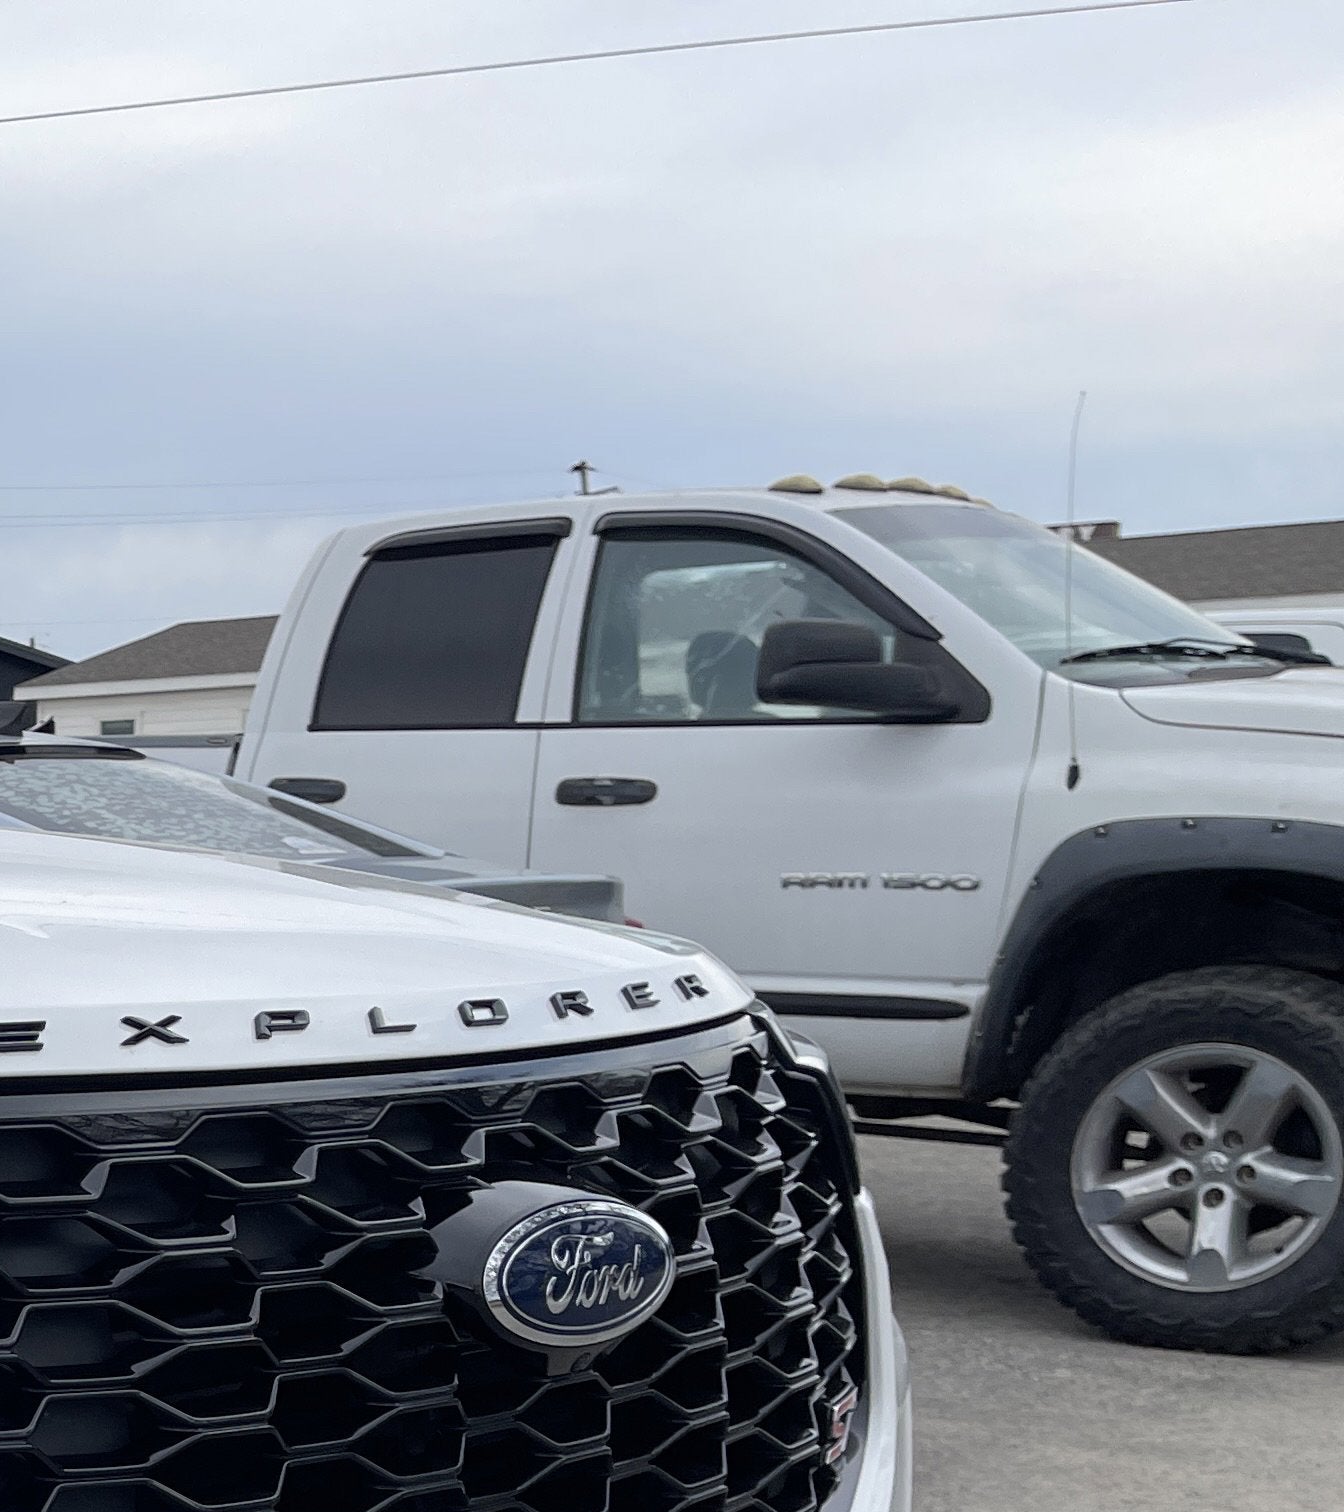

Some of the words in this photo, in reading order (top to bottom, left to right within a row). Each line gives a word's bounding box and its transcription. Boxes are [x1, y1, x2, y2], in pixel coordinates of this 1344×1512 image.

[780, 872, 868, 890] RAM
[880, 872, 980, 891] 1500
[545, 1231, 645, 1315] Ford
